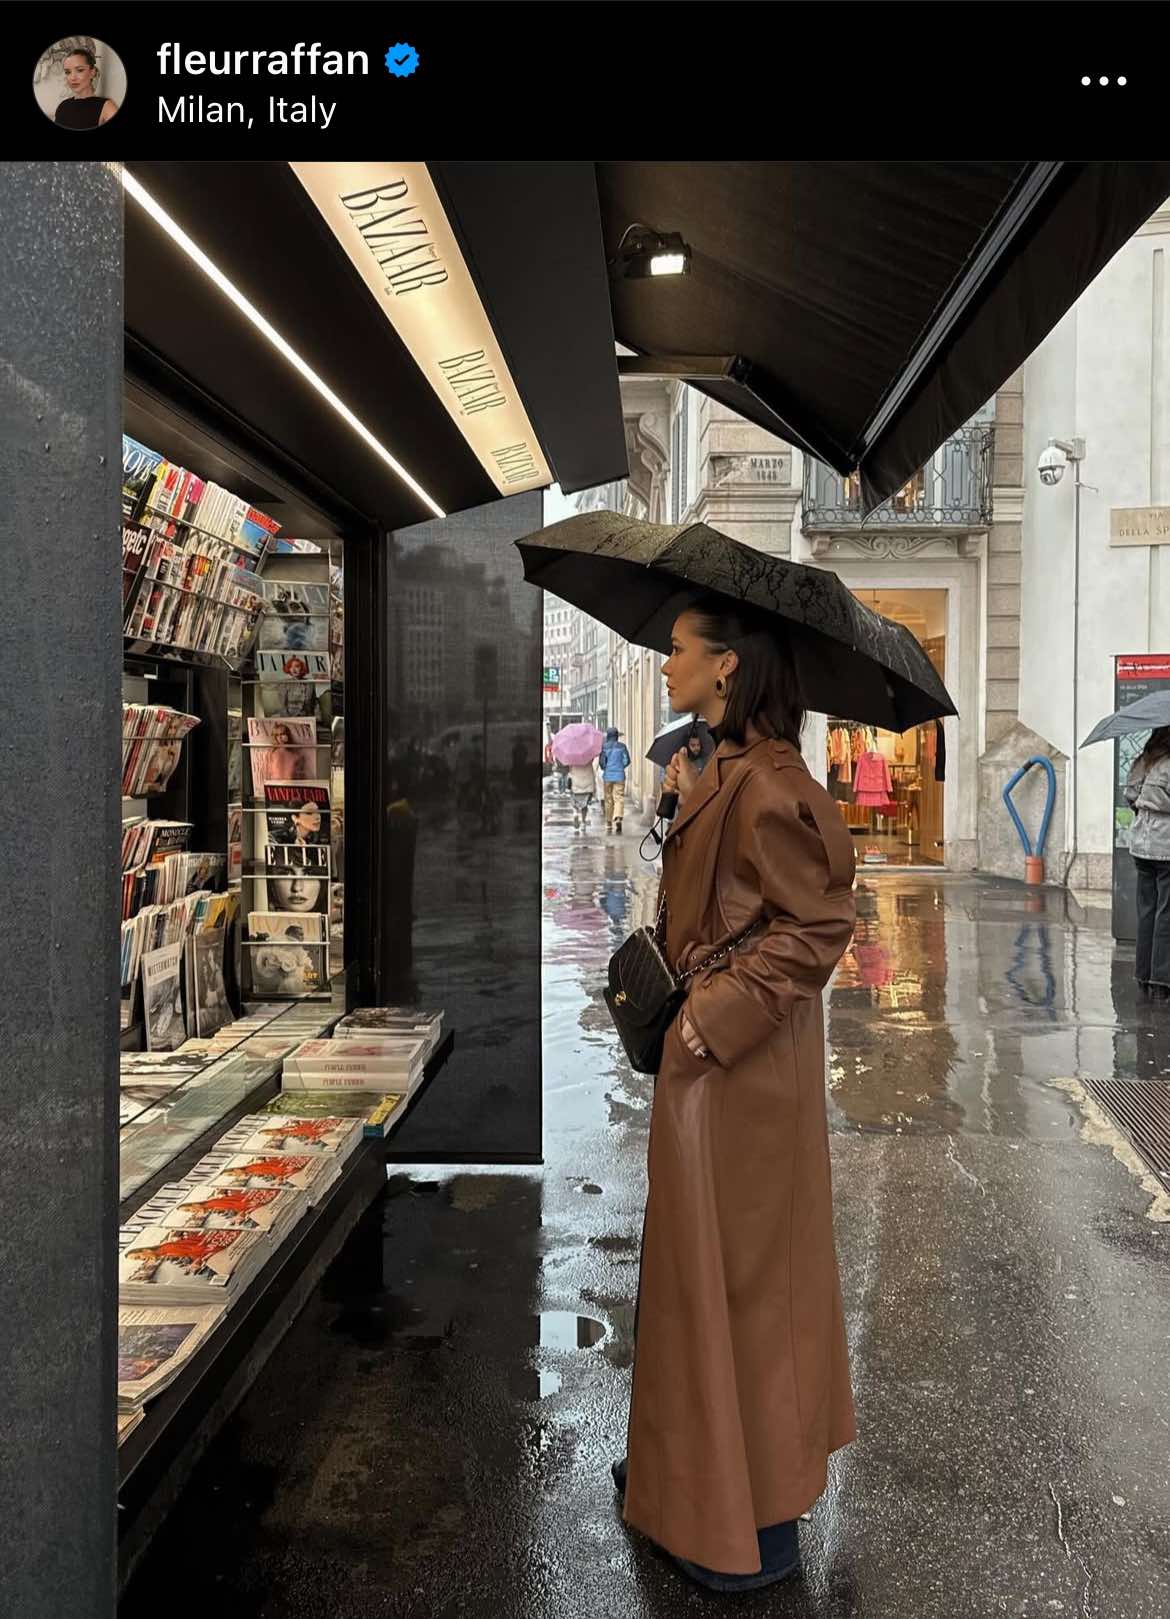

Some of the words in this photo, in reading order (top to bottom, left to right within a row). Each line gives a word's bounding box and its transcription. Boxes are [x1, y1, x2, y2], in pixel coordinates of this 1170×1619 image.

[338, 176, 449, 296] BAZAAR
[438, 349, 506, 416] BAZAAR
[751, 457, 783, 469] MARZO
[267, 786, 301, 801] VANITY
[303, 788, 327, 801] FAIR
[266, 845, 327, 866] ELLE
